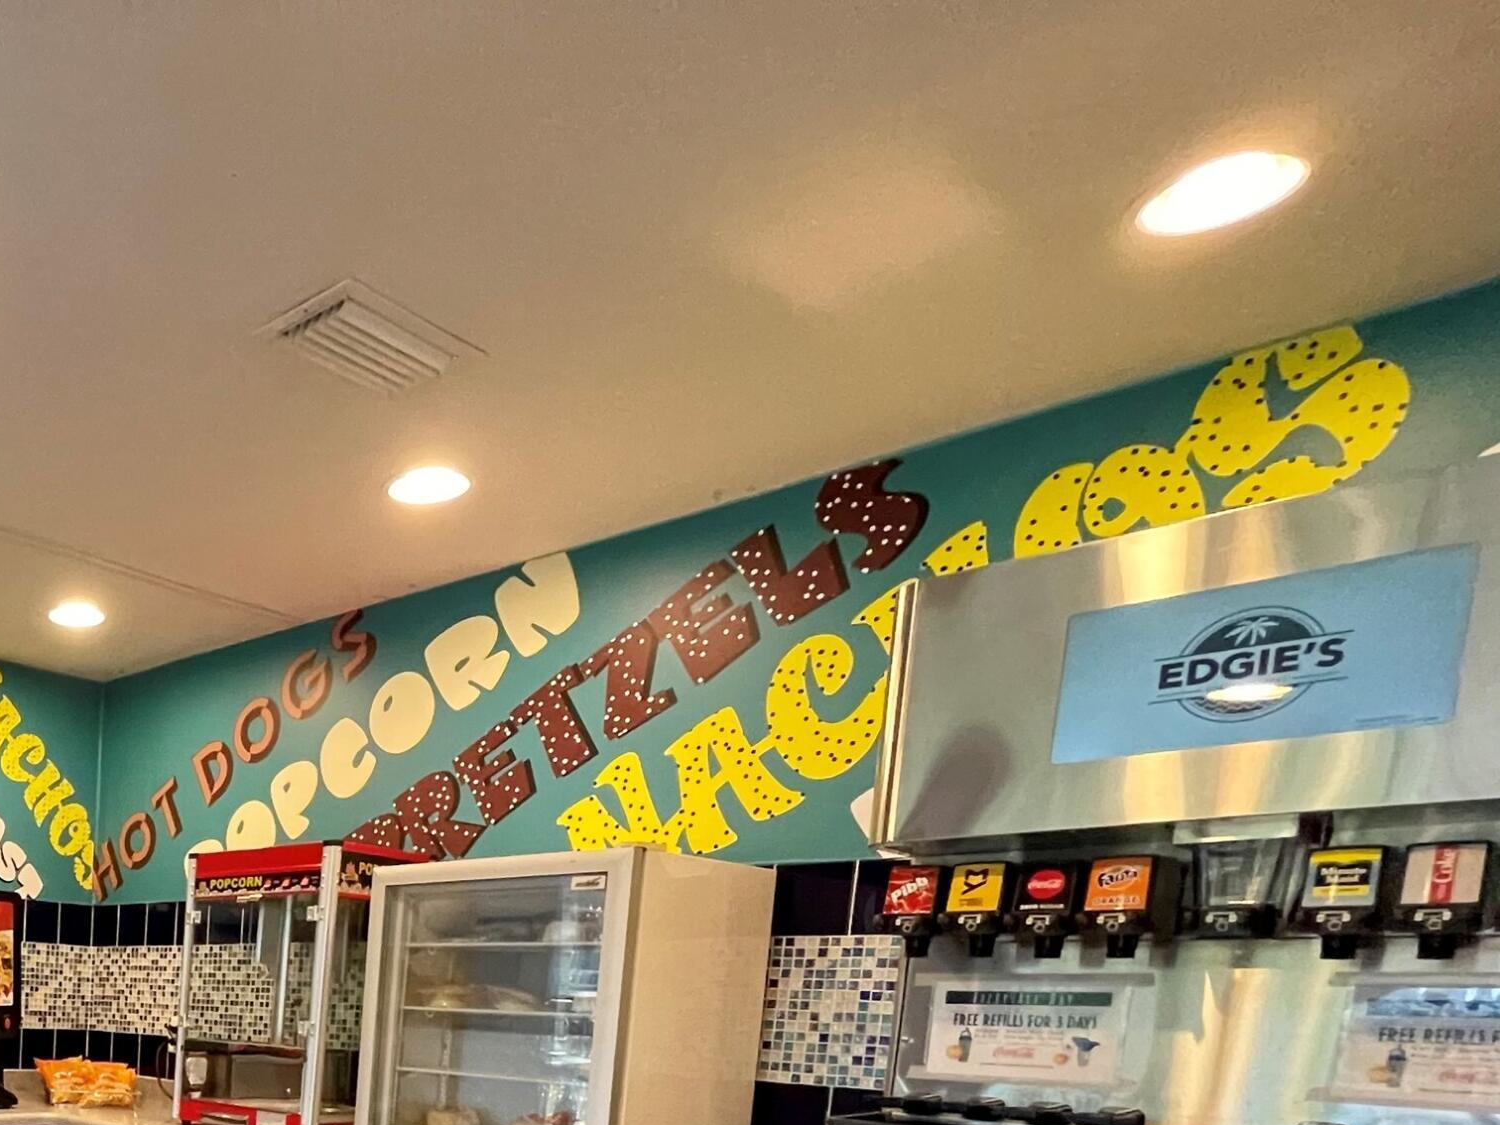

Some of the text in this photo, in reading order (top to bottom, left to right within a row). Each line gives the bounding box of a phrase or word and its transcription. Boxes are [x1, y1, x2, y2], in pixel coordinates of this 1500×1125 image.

[556, 326, 1411, 854] NACOS
[1158, 638, 1348, 690] EDGIE'S
[185, 551, 581, 880] OPCORN
[90, 608, 378, 901] HOT DOGS
[210, 876, 263, 890] POPCORN
[953, 1012, 979, 1027] FREE
[1027, 1014, 1051, 1028] FOR
[1378, 1026, 1416, 1043] FREE
